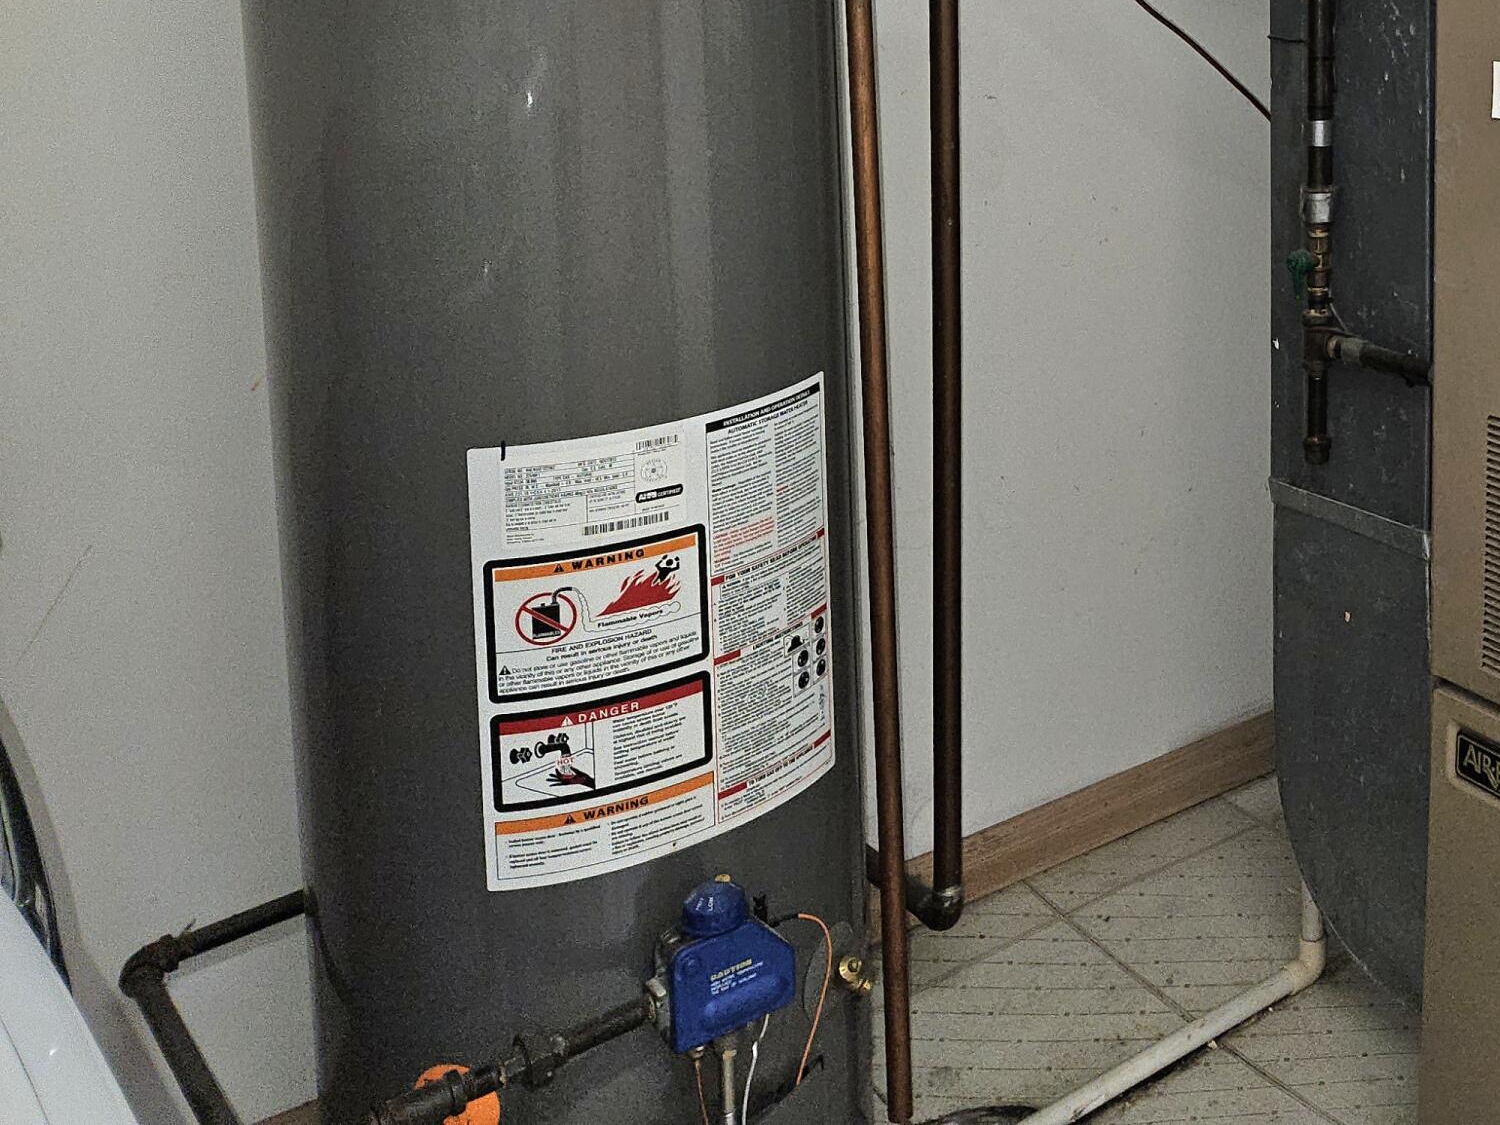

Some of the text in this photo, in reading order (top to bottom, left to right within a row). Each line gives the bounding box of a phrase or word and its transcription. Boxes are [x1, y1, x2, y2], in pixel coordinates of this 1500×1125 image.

[571, 549, 645, 570] WARNING
[598, 615, 637, 627] Flammable
[585, 636, 623, 649] EXPLOSION
[624, 629, 652, 639] HAZARD
[578, 702, 640, 723] DANGER
[557, 757, 574, 766] HOT
[583, 796, 649, 820] WARNING
[710, 958, 752, 982] CAUTION
